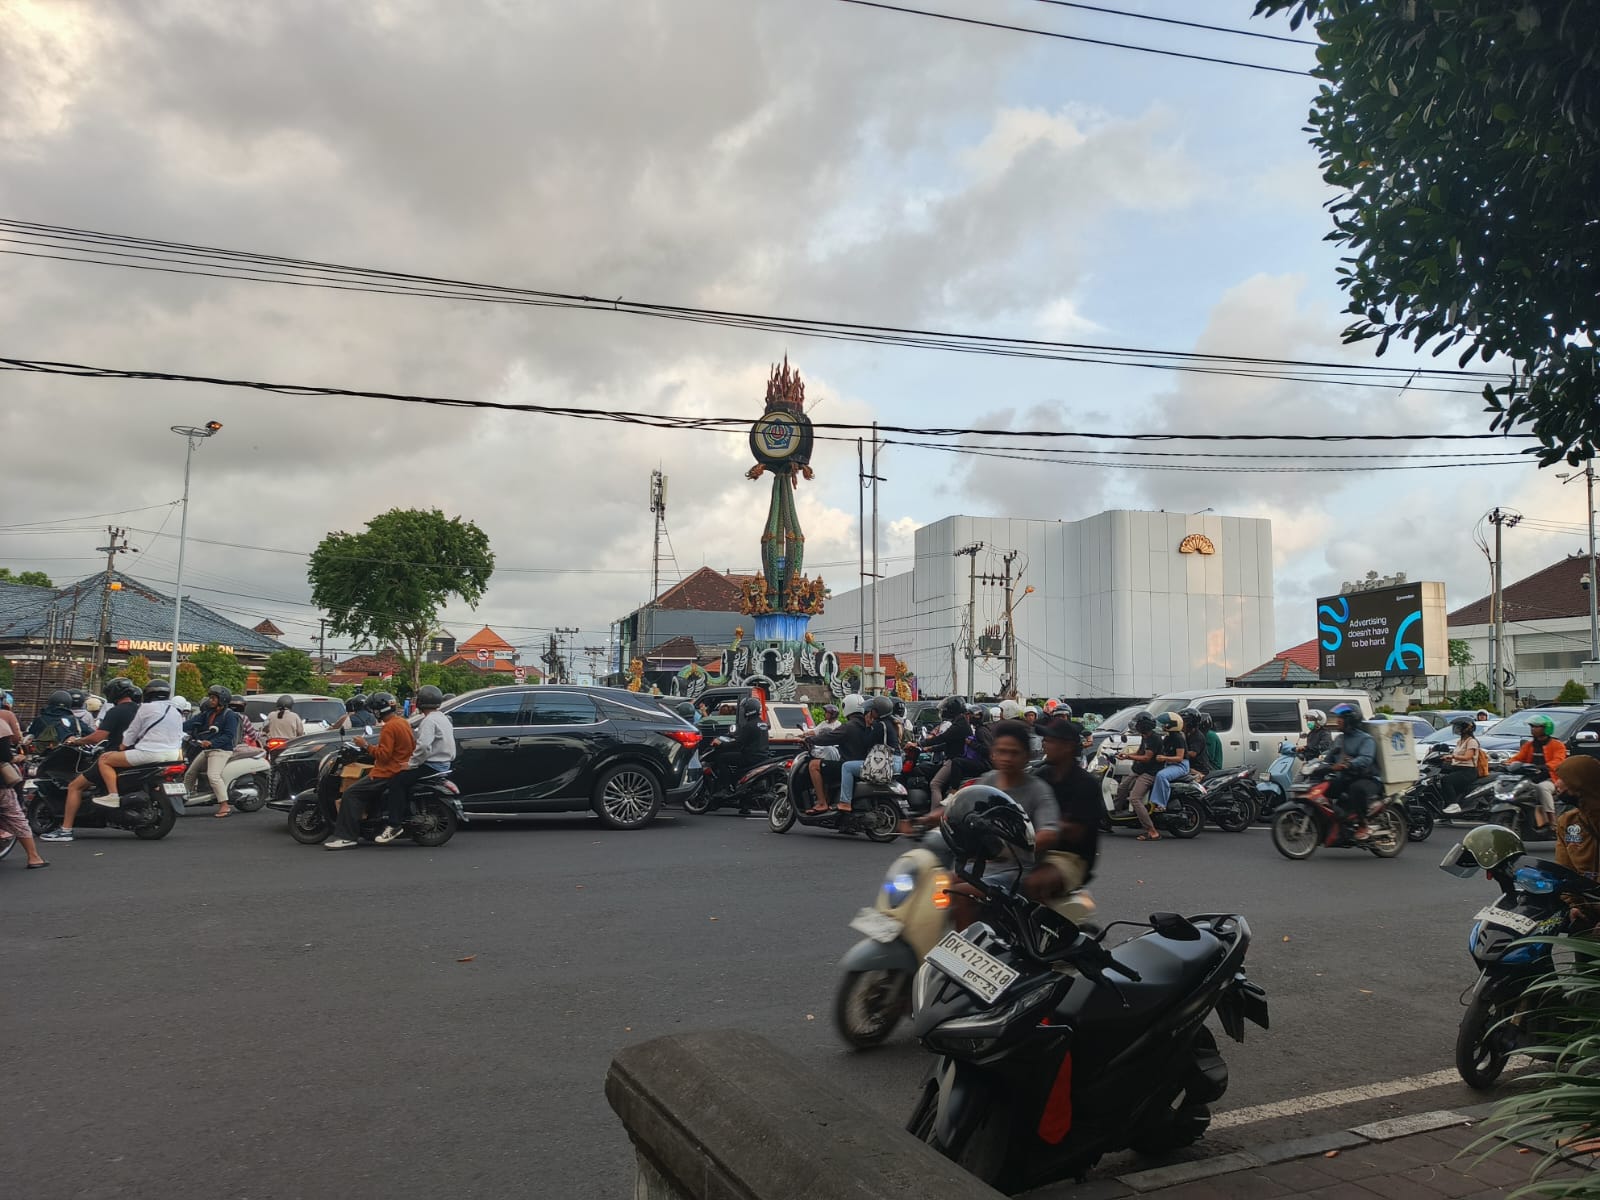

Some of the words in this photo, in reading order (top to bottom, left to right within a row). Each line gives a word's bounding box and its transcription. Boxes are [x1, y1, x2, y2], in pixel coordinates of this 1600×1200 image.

[1349, 617, 1387, 628] Advertising
[1347, 629, 1371, 638] doesn't
[1372, 627, 1389, 636] have
[129, 640, 200, 653] MARUGAME
[1360, 639, 1368, 647] be
